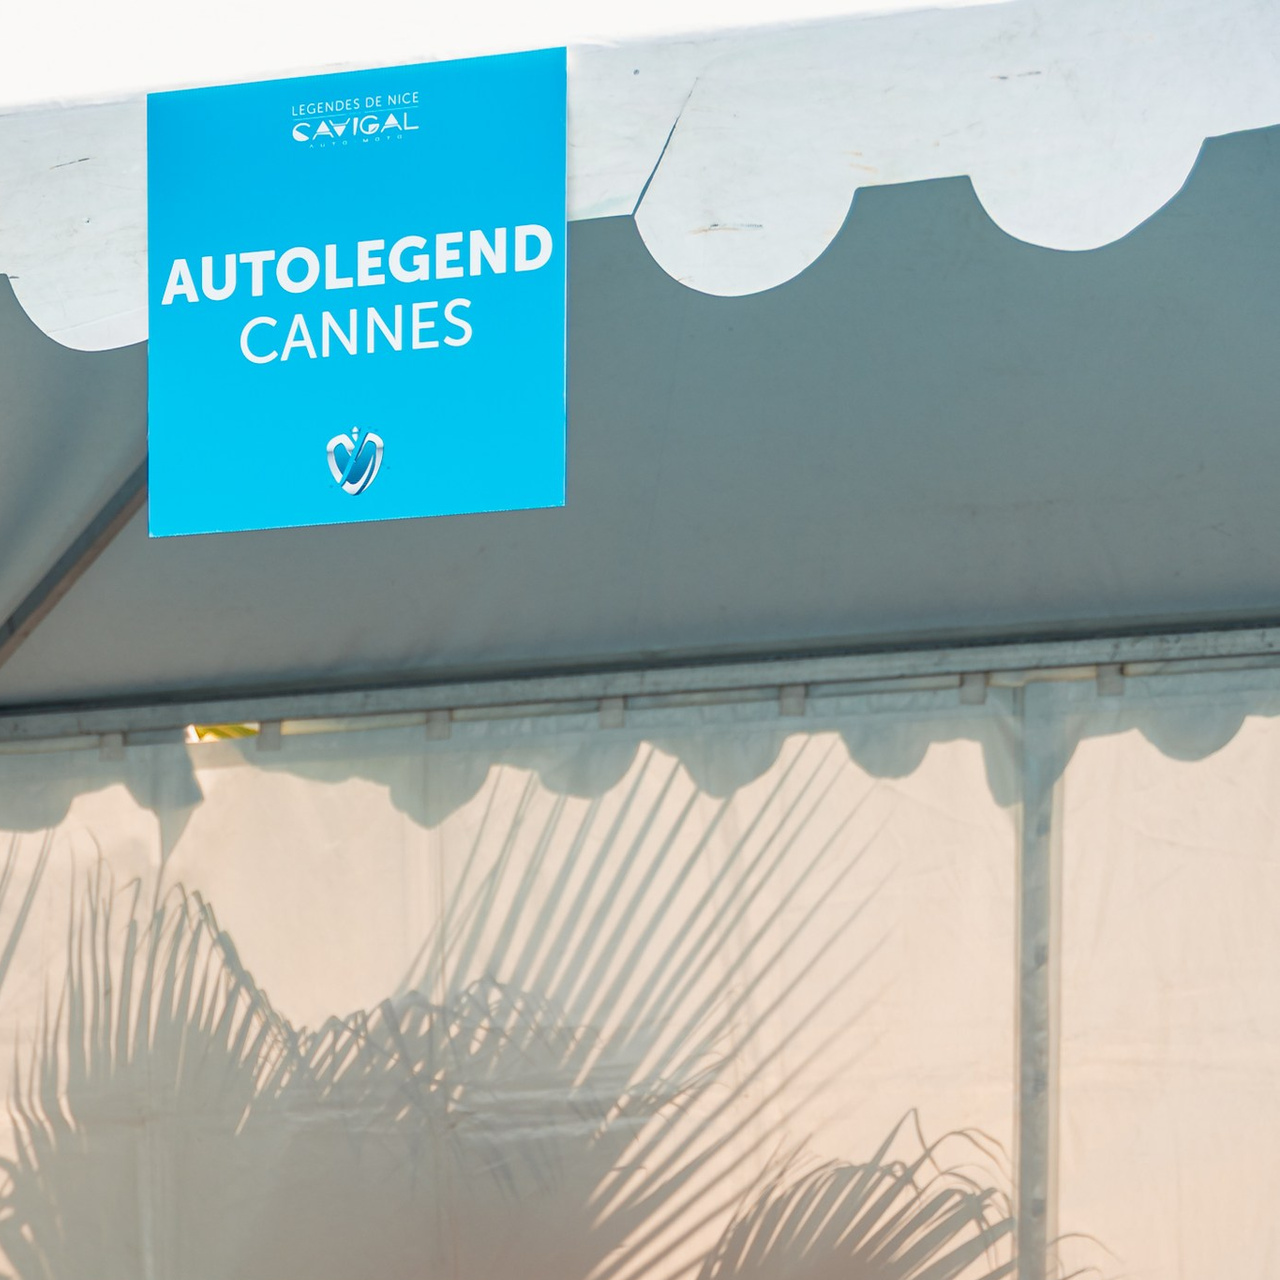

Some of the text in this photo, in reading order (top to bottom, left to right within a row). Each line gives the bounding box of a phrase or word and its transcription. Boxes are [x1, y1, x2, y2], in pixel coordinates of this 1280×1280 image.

[291, 91, 419, 117] LEGENDES DE NICE
[161, 223, 553, 305] AUTOLEGEND
[239, 298, 473, 365] CANNES
